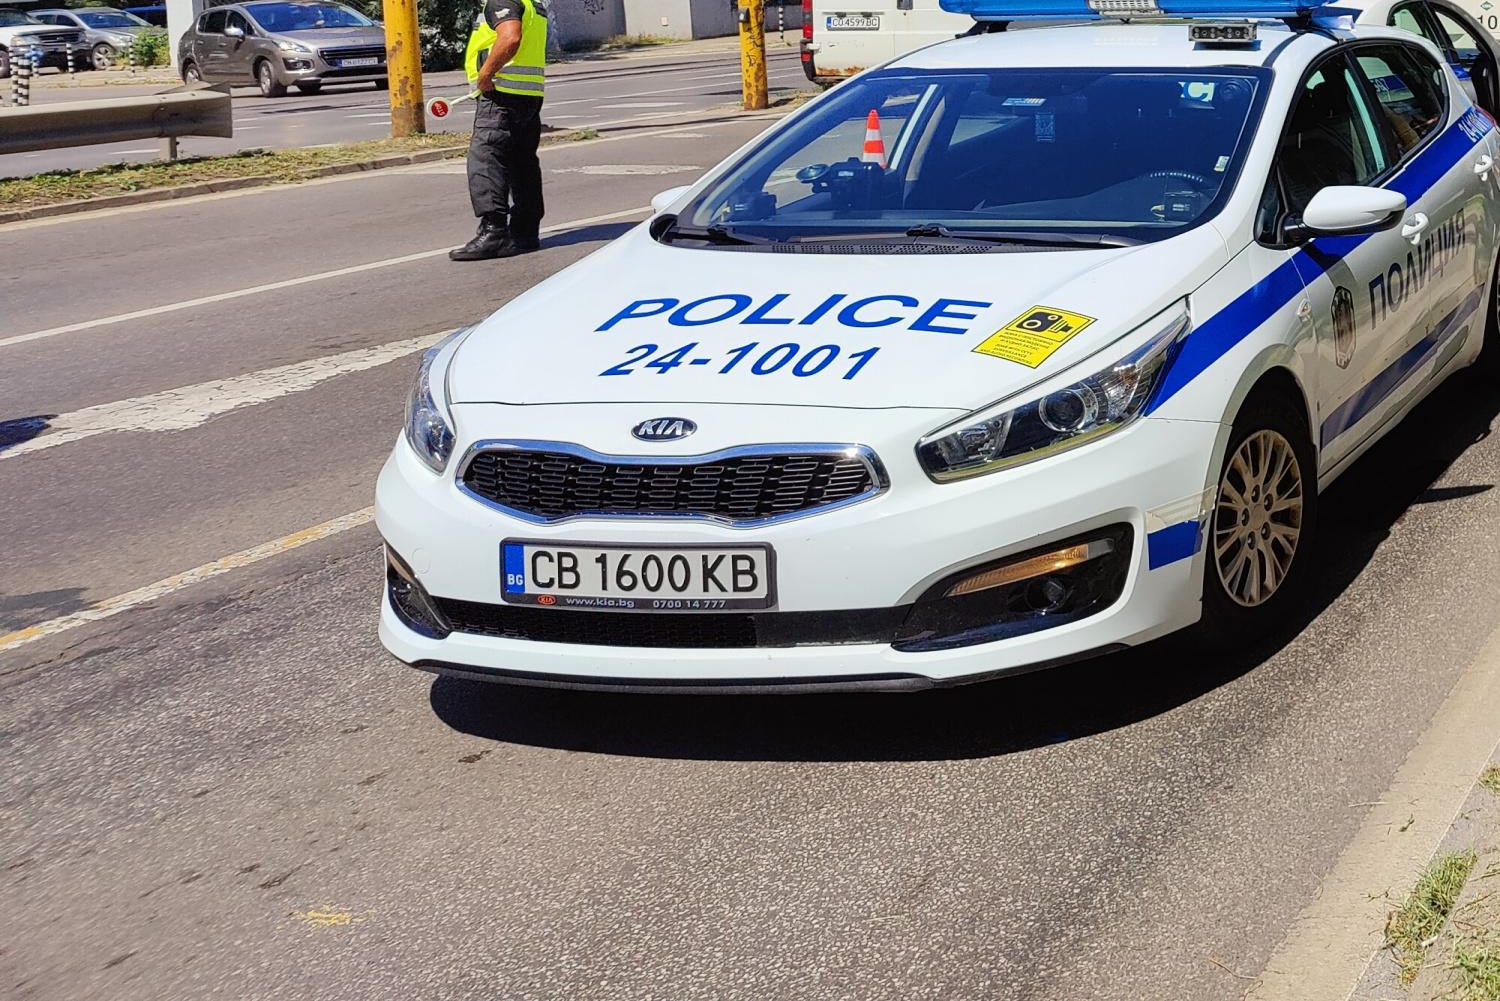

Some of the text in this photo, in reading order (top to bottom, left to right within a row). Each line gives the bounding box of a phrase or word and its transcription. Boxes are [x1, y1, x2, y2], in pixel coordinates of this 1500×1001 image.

[1368, 207, 1466, 330] ПОЛИЦИЯ
[593, 293, 993, 335] POLICE
[598, 341, 881, 381] 24-1001
[638, 419, 685, 436] KIA
[507, 573, 524, 586] BG
[531, 550, 759, 593] CB 1600 KB
[565, 597, 726, 608] www.kia.bg 0700 14 777
